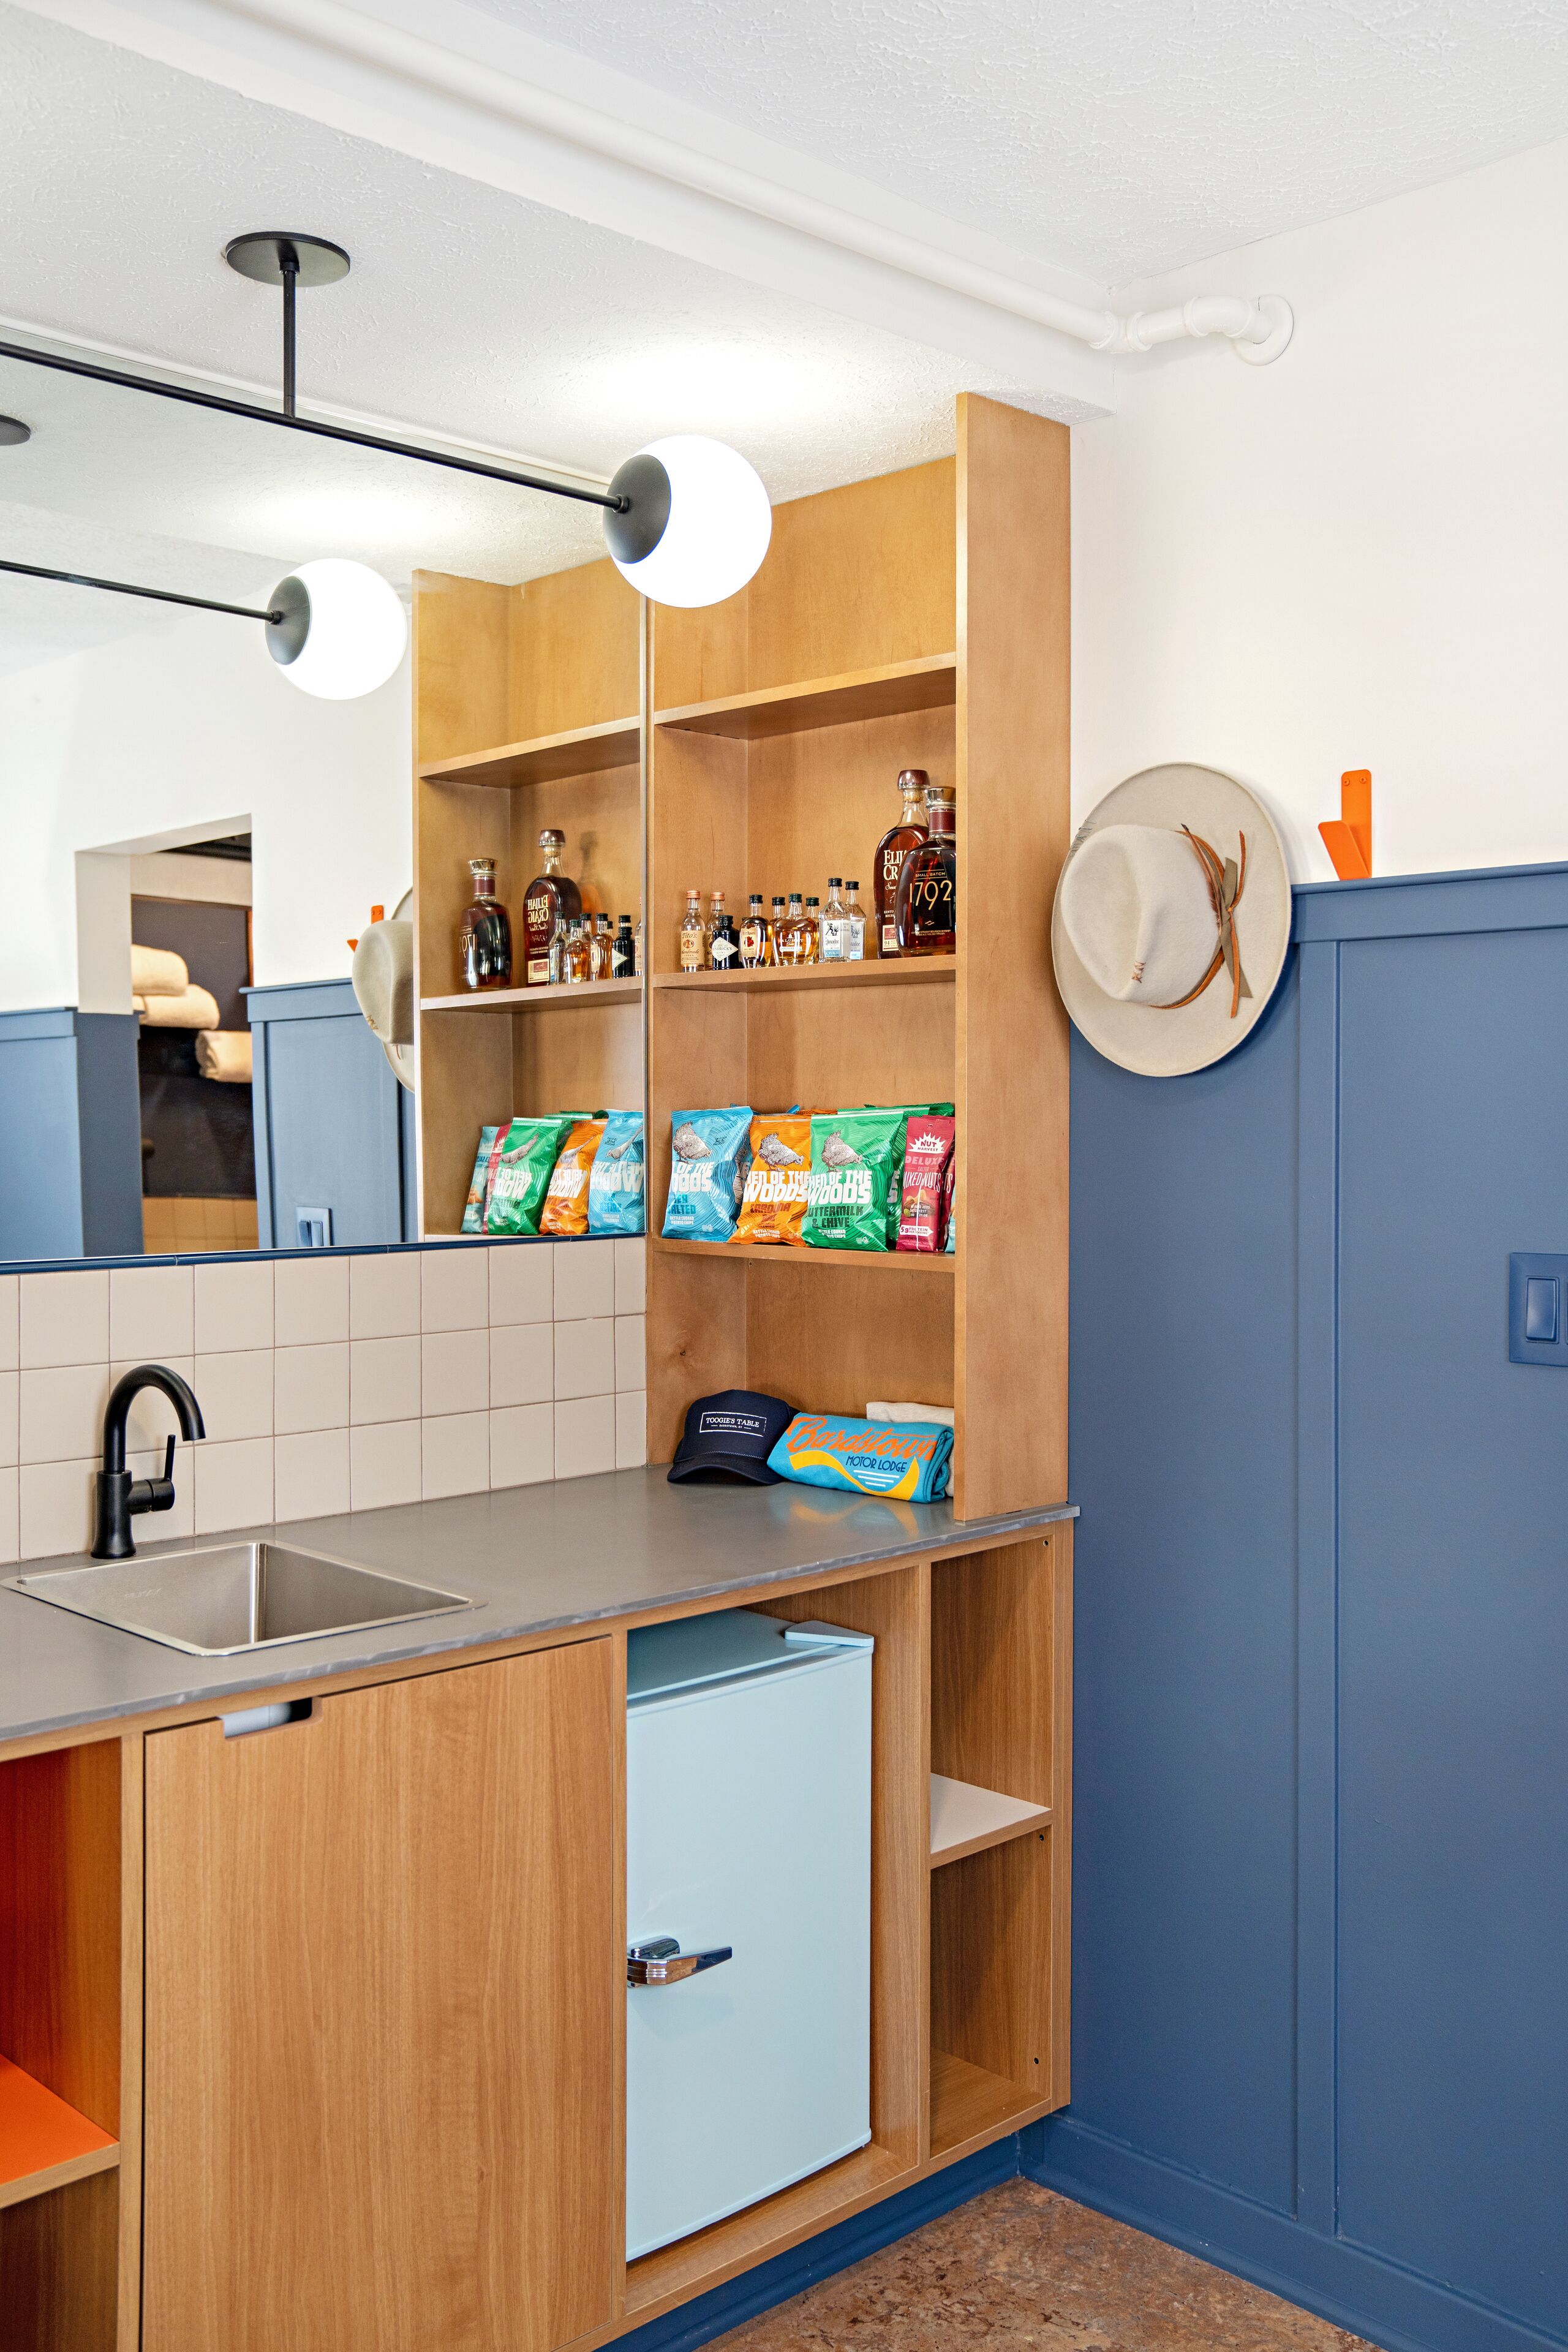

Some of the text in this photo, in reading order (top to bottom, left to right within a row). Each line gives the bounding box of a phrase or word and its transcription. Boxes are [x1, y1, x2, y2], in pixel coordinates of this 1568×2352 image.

[883, 850, 907, 866] ELIJ
[910, 880, 952, 910] 1792
[677, 1161, 714, 1174] OF THE
[770, 1171, 785, 1184] OF
[809, 1170, 872, 1189] HEN OF THE
[921, 1172, 941, 1193] NUTS
[743, 1183, 809, 1202] WOODS
[807, 1183, 872, 1206] WOODS
[750, 1202, 791, 1213] CAROLINA
[809, 1206, 864, 1218] UTTERMILK
[812, 1217, 850, 1228] & CHIVE
[737, 1419, 760, 1428] TABLE
[786, 1417, 938, 1461] Bardstown
[845, 1455, 907, 1472] MOTOR LODGE
